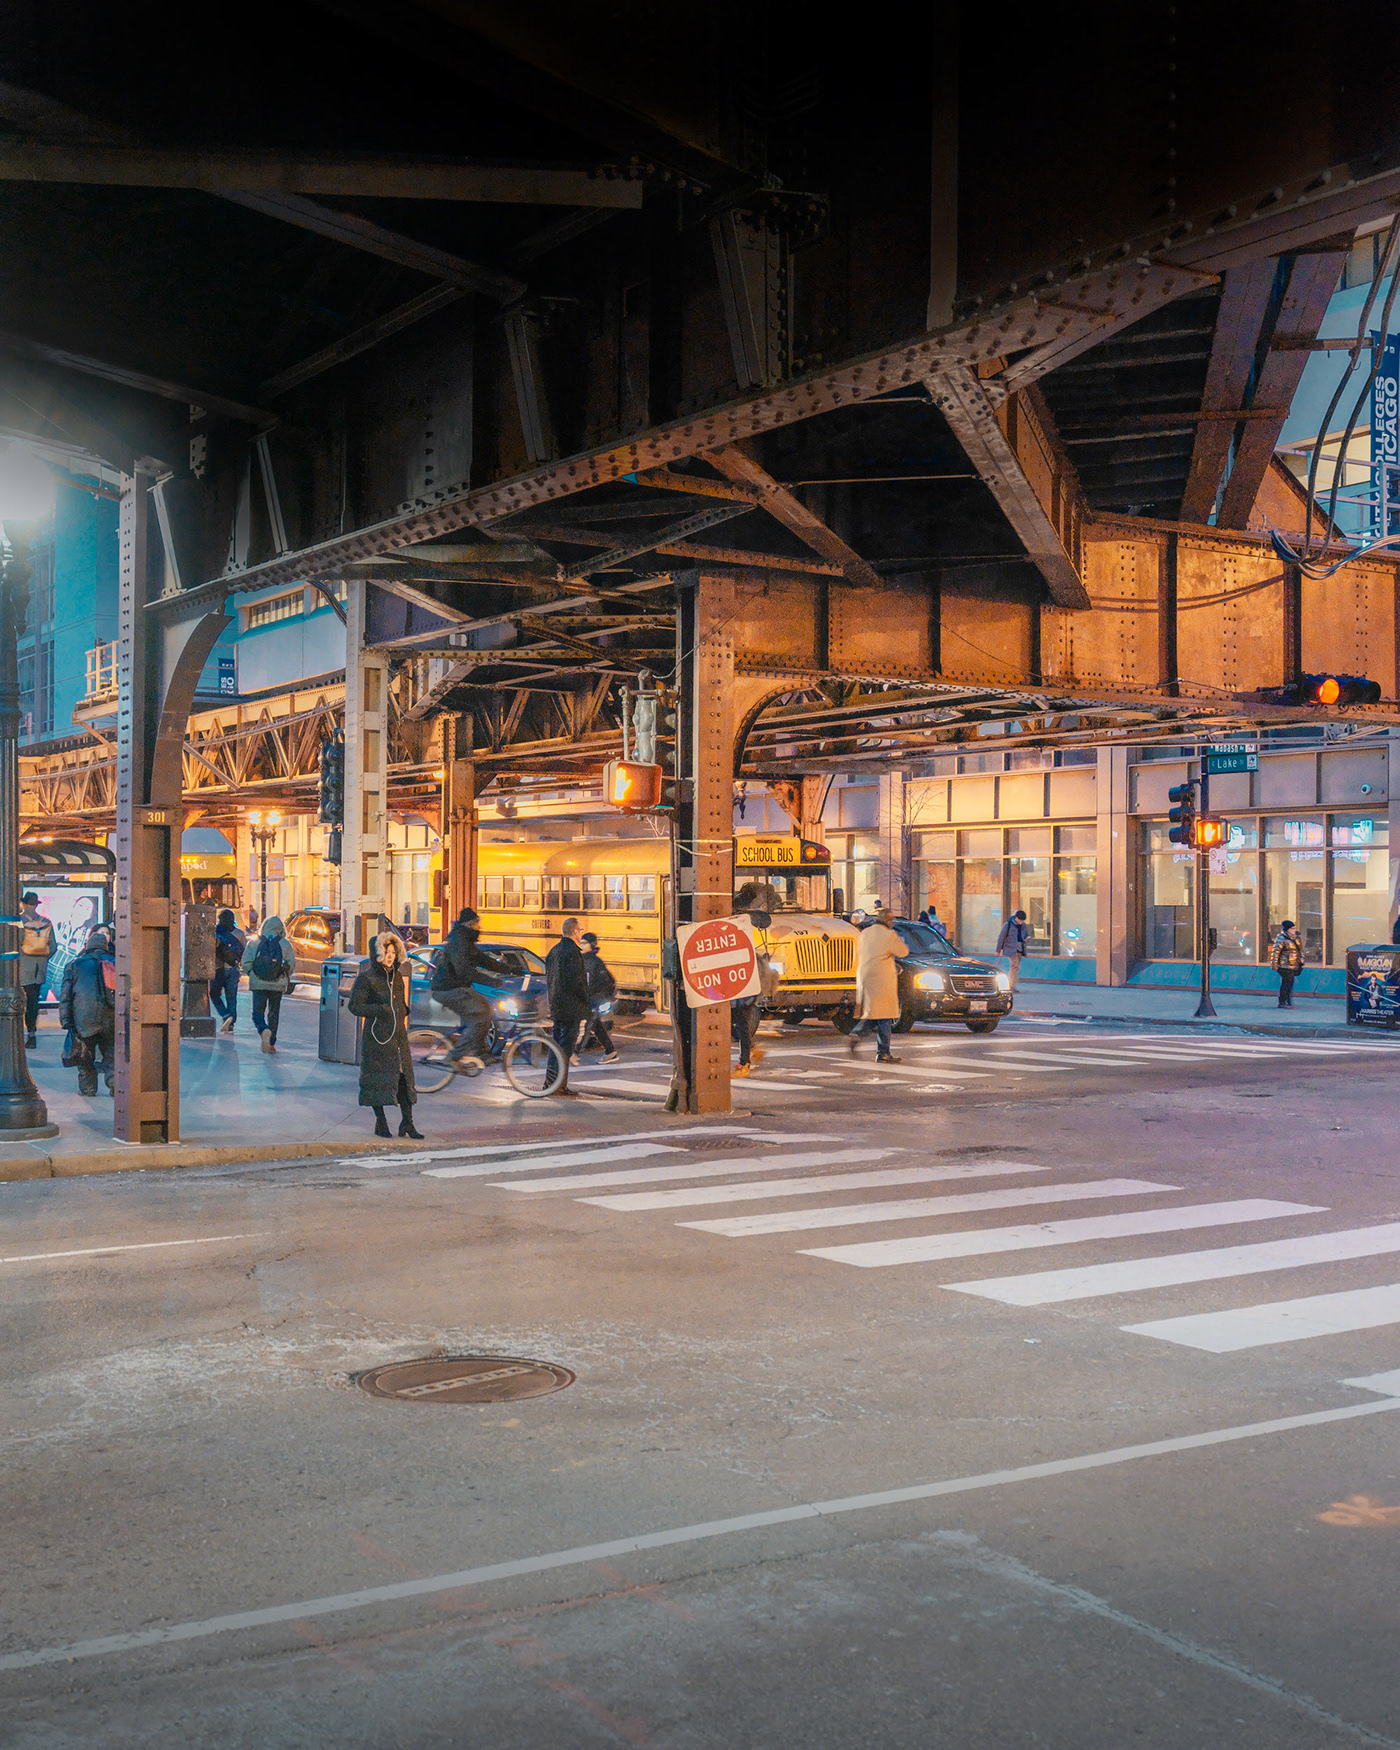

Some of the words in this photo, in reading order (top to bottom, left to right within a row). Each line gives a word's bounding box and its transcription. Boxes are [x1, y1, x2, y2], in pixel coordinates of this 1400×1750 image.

[1384, 376, 1398, 463] ICAGO
[1217, 758, 1237, 769] Lake
[147, 811, 165, 823] 301
[742, 847, 775, 863] SCHOOL
[777, 847, 794, 863] BUS
[180, 860, 207, 872] apod
[696, 933, 737, 953] ENTER
[697, 973, 721, 990] NOT
[728, 968, 747, 983] DO
